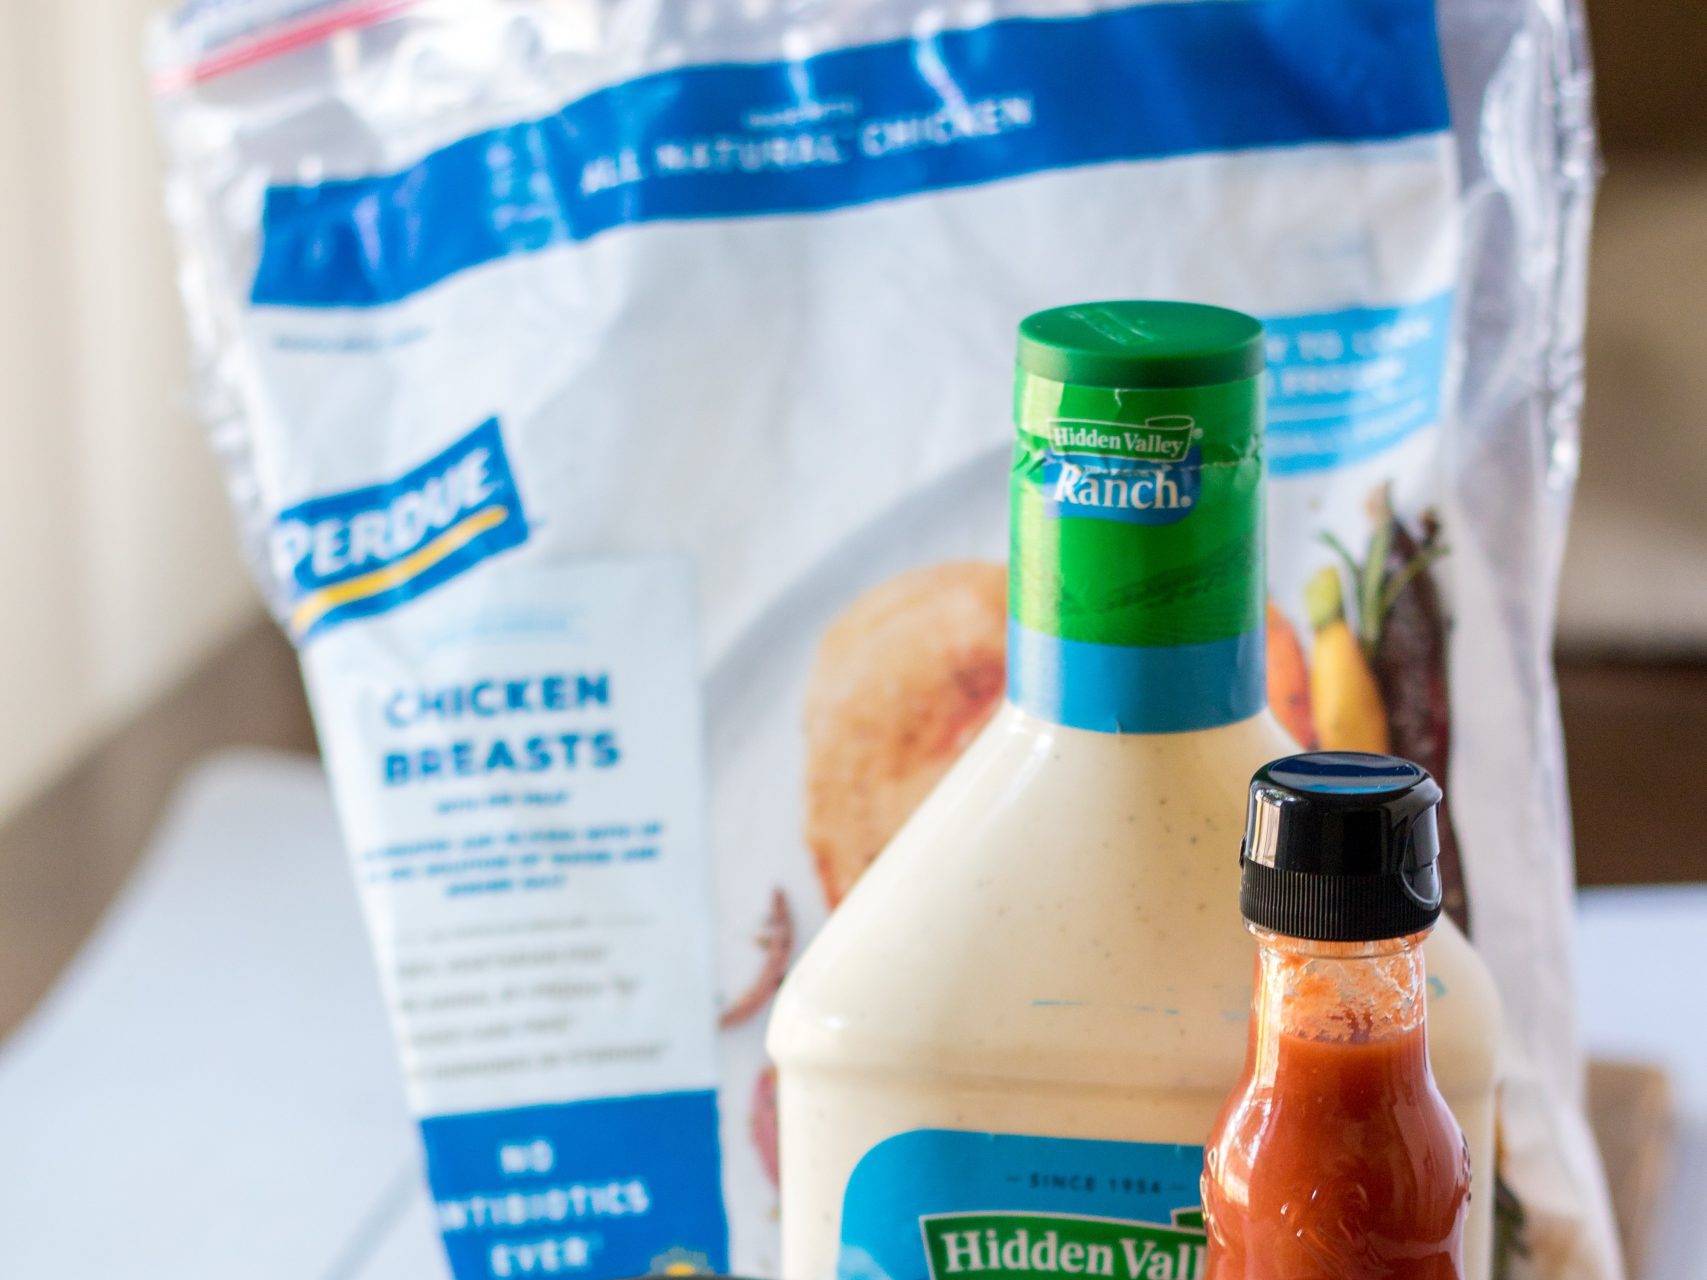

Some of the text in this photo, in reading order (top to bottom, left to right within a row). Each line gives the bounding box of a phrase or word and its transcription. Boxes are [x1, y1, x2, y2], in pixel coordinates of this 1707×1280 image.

[655, 132, 846, 174] NATURAL
[860, 96, 1034, 158] CHICKEN
[1054, 427, 1184, 458] Hidden Valley
[271, 447, 496, 578] PERDUE
[384, 672, 611, 728] CHICKEN
[384, 731, 622, 787] BREASTS
[502, 1139, 554, 1174] NO
[439, 1179, 650, 1230] NTIBIOTICS
[1029, 1171, 1162, 1196] SINCE 1954
[940, 1228, 1115, 1277] Hidden
